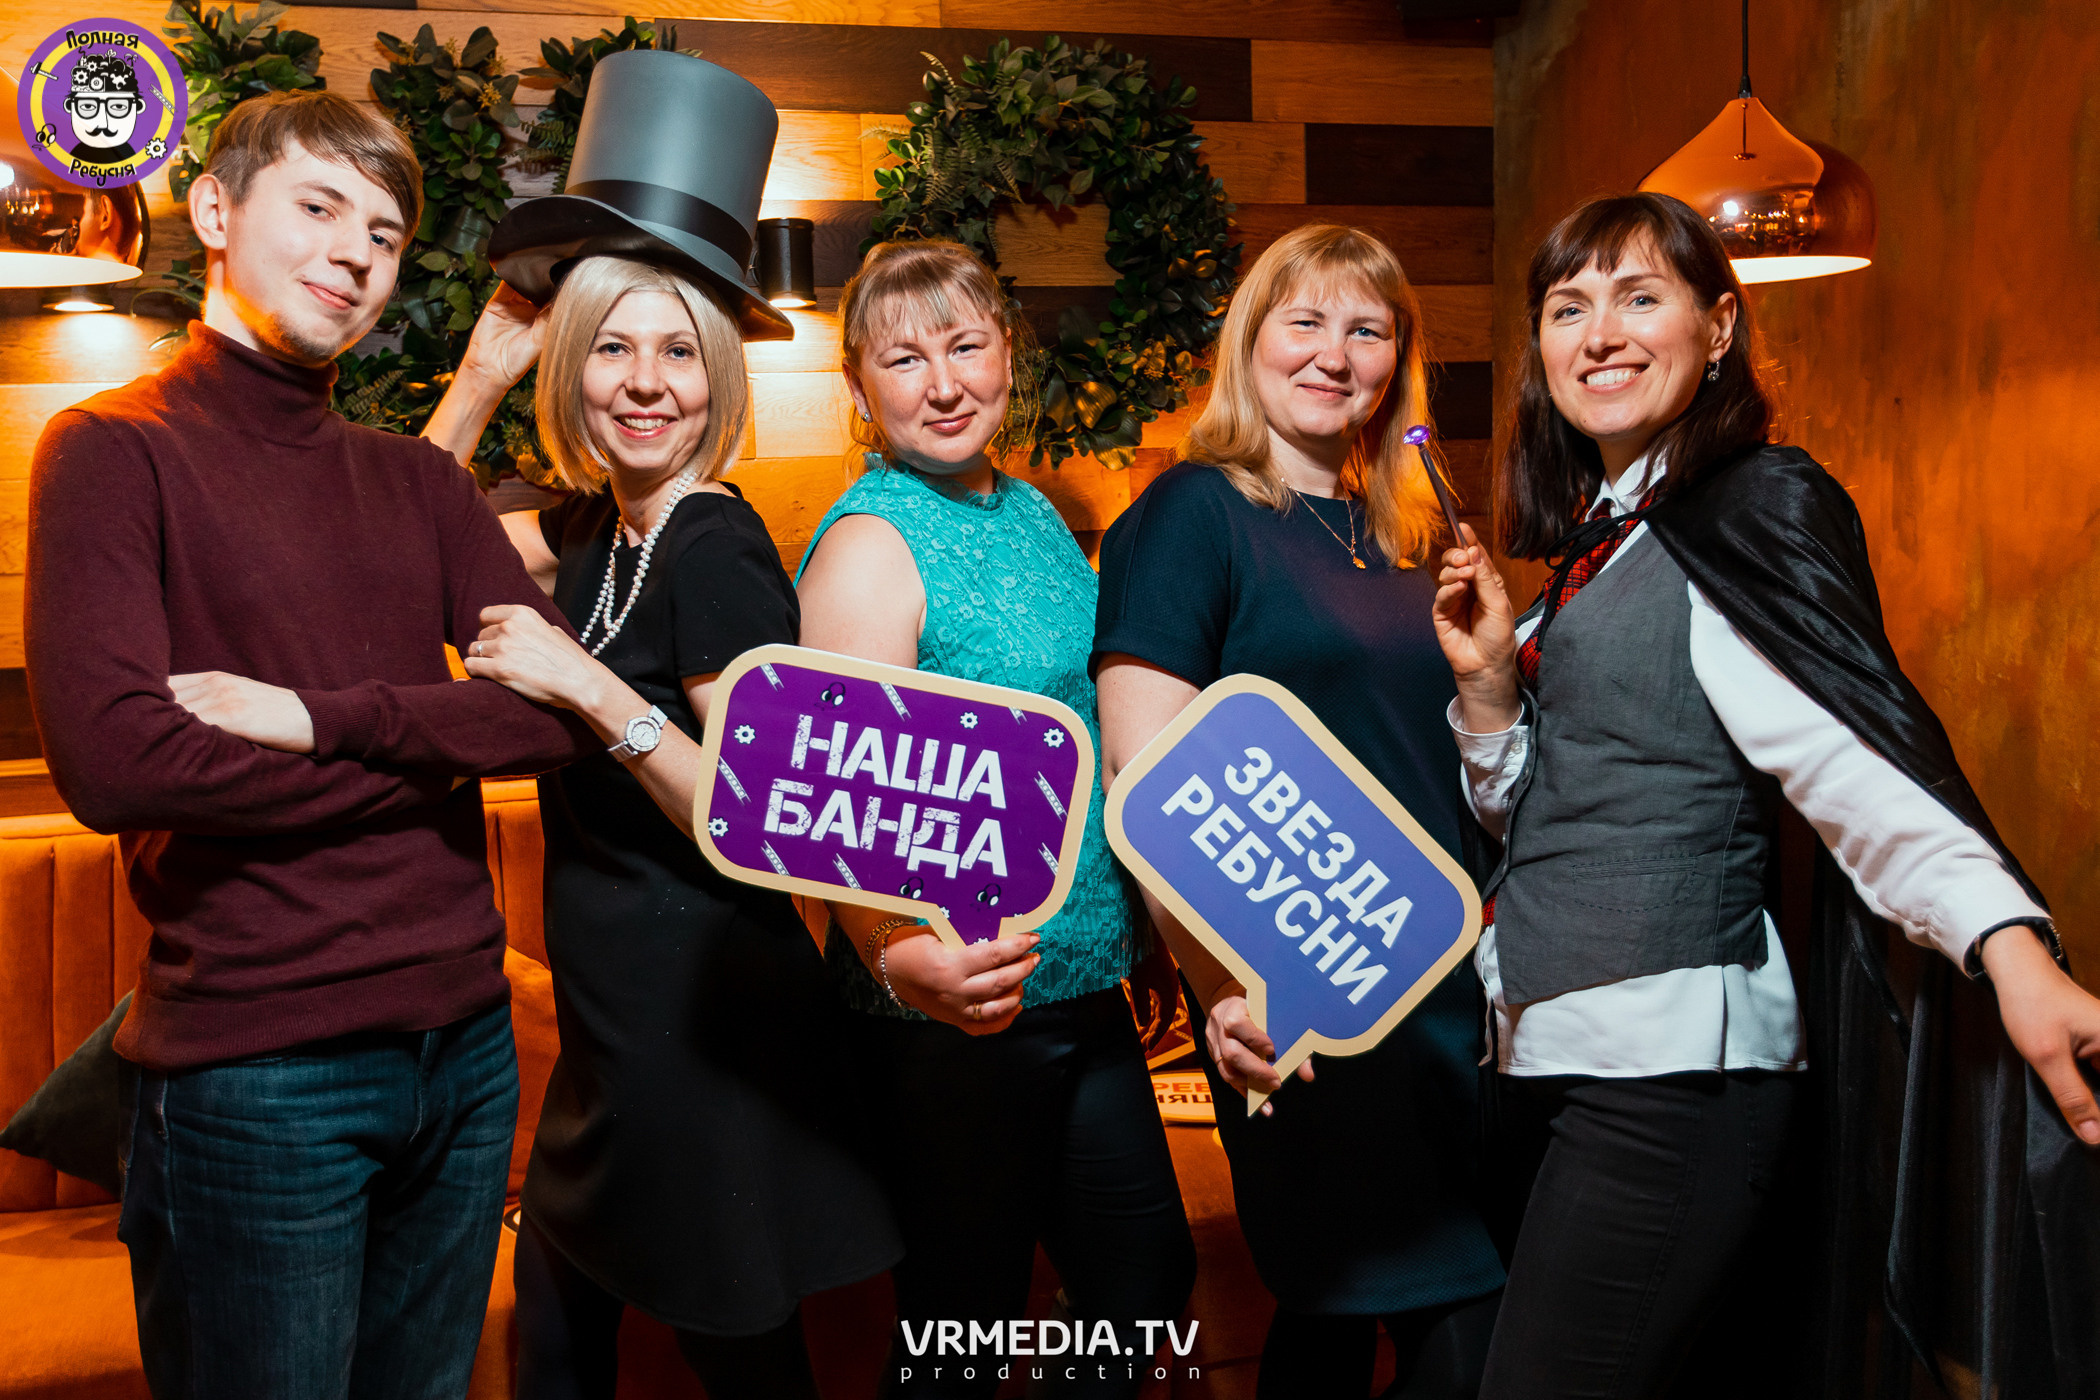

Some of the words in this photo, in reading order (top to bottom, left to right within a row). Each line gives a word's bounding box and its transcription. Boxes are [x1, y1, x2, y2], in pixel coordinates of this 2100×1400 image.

[763, 778, 1008, 879] БАНДА
[790, 713, 1007, 809] НАША
[1160, 773, 1389, 1005] РЕБУСНИ
[1224, 746, 1413, 949] ЗВЕЗДА
